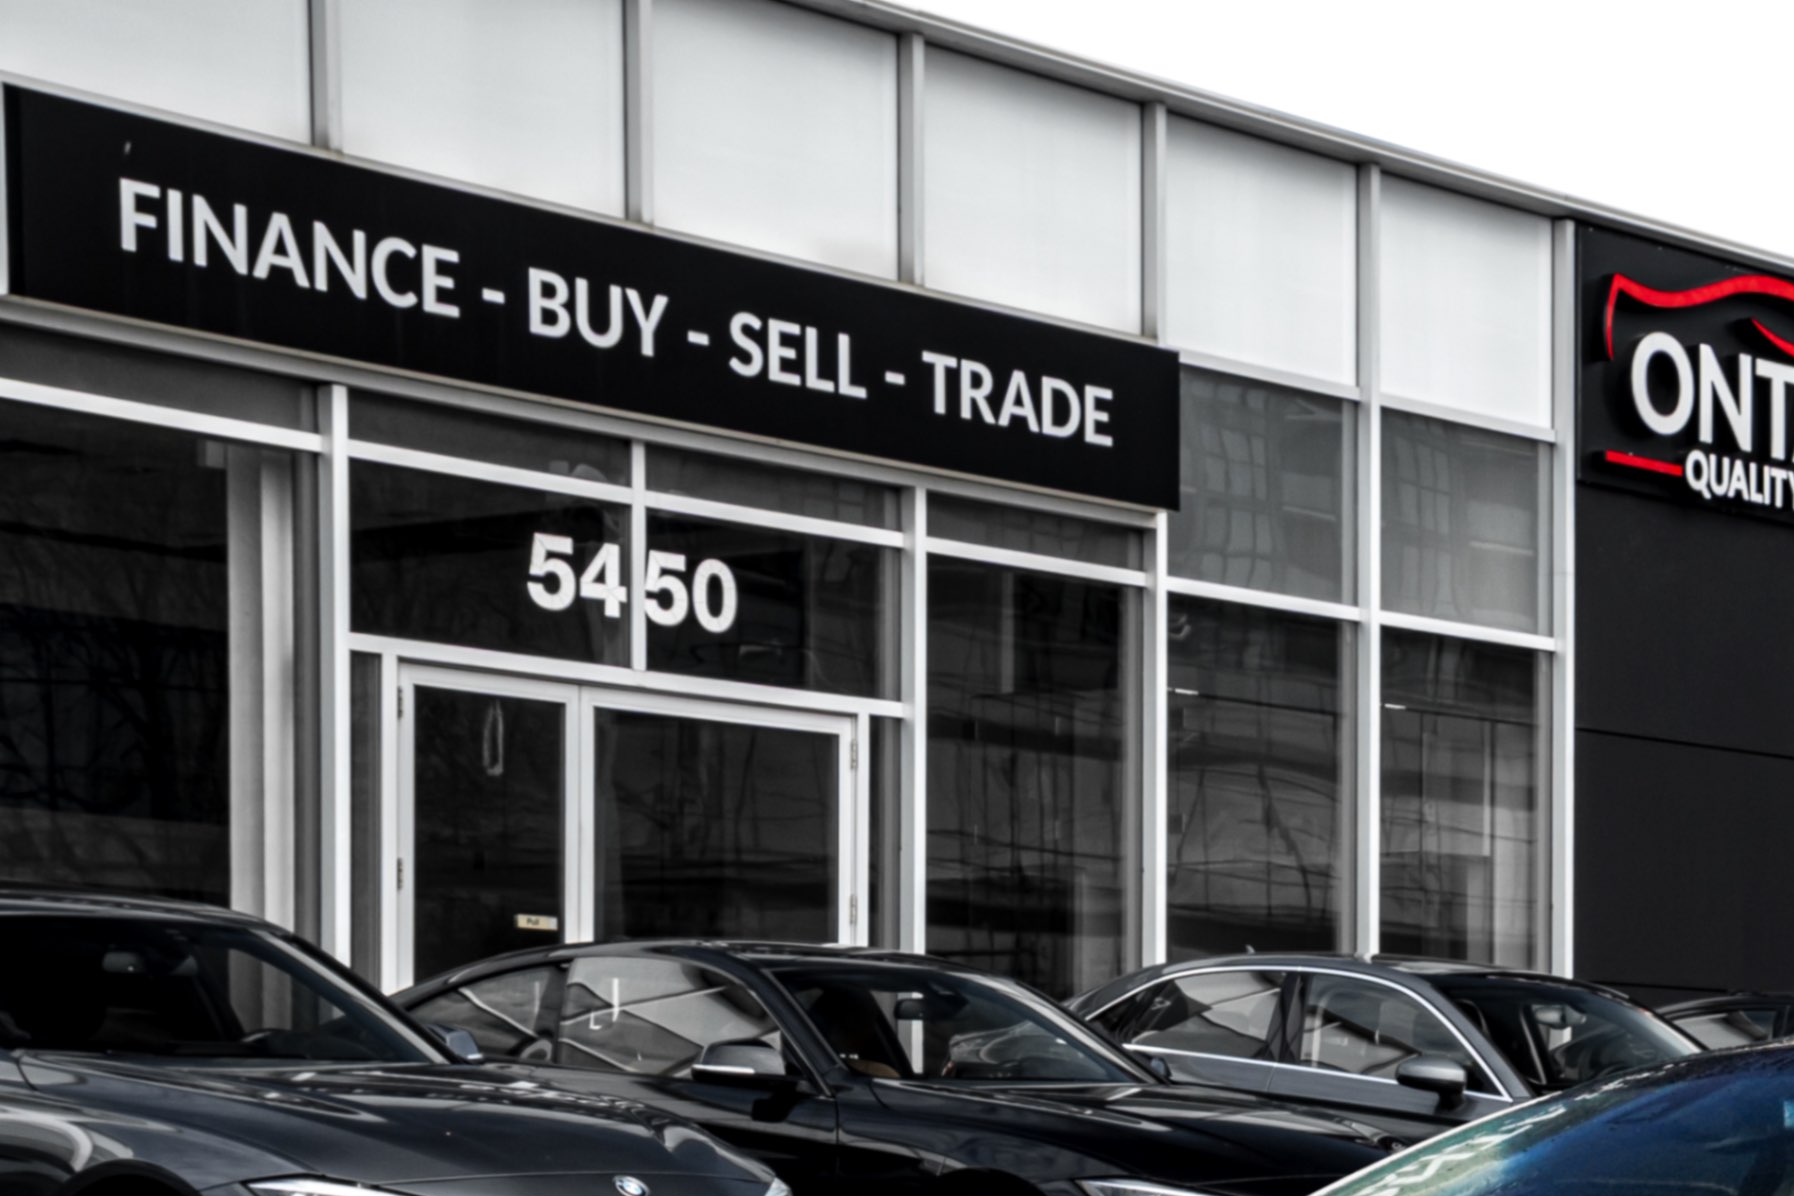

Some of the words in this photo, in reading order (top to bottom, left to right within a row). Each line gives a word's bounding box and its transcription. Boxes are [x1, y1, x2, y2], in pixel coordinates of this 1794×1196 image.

[119, 177, 460, 318] FINANCE
[528, 267, 669, 357] BUY
[729, 311, 867, 399] SELL
[921, 350, 1113, 447] TRADE
[527, 532, 737, 633] 5450
